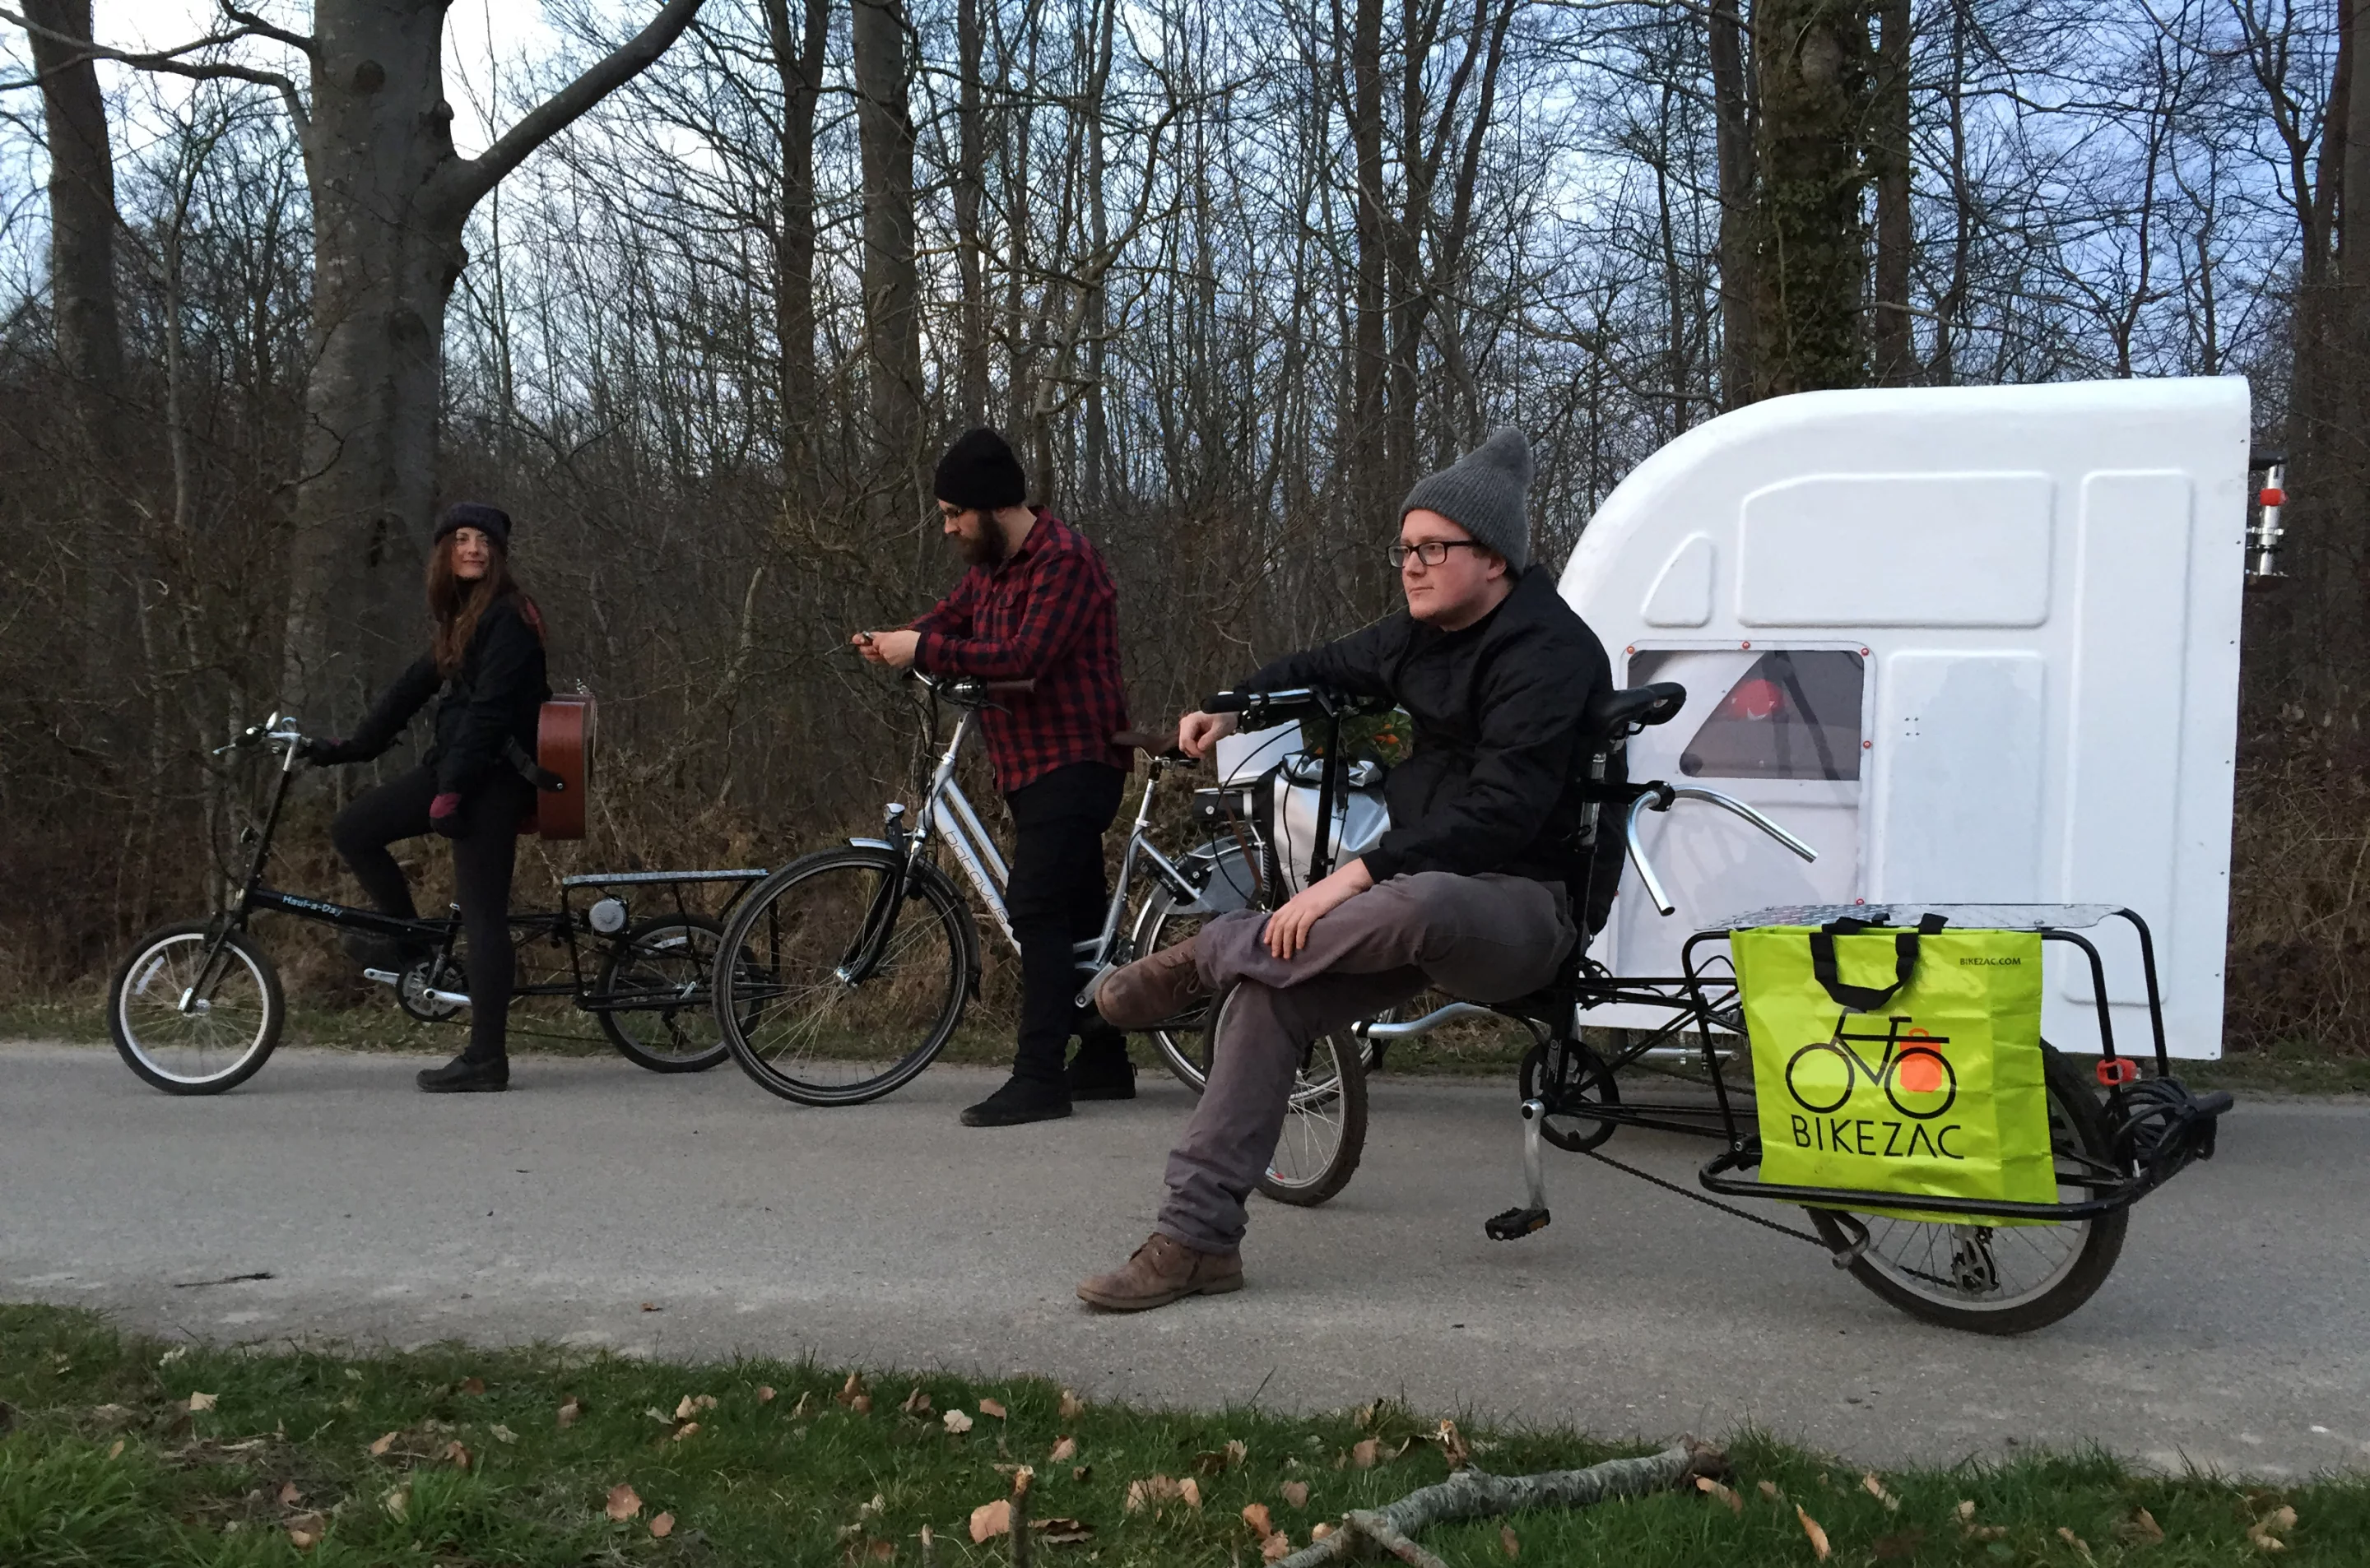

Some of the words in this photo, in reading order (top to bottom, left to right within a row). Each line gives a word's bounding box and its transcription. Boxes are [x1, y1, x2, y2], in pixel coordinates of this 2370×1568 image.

[944, 830, 1009, 925] batavus
[282, 895, 343, 917] Haul-a-Day
[1959, 957, 2022, 966] BIKEZAC.COM
[1791, 1114, 1964, 1160] BIKEZAC
